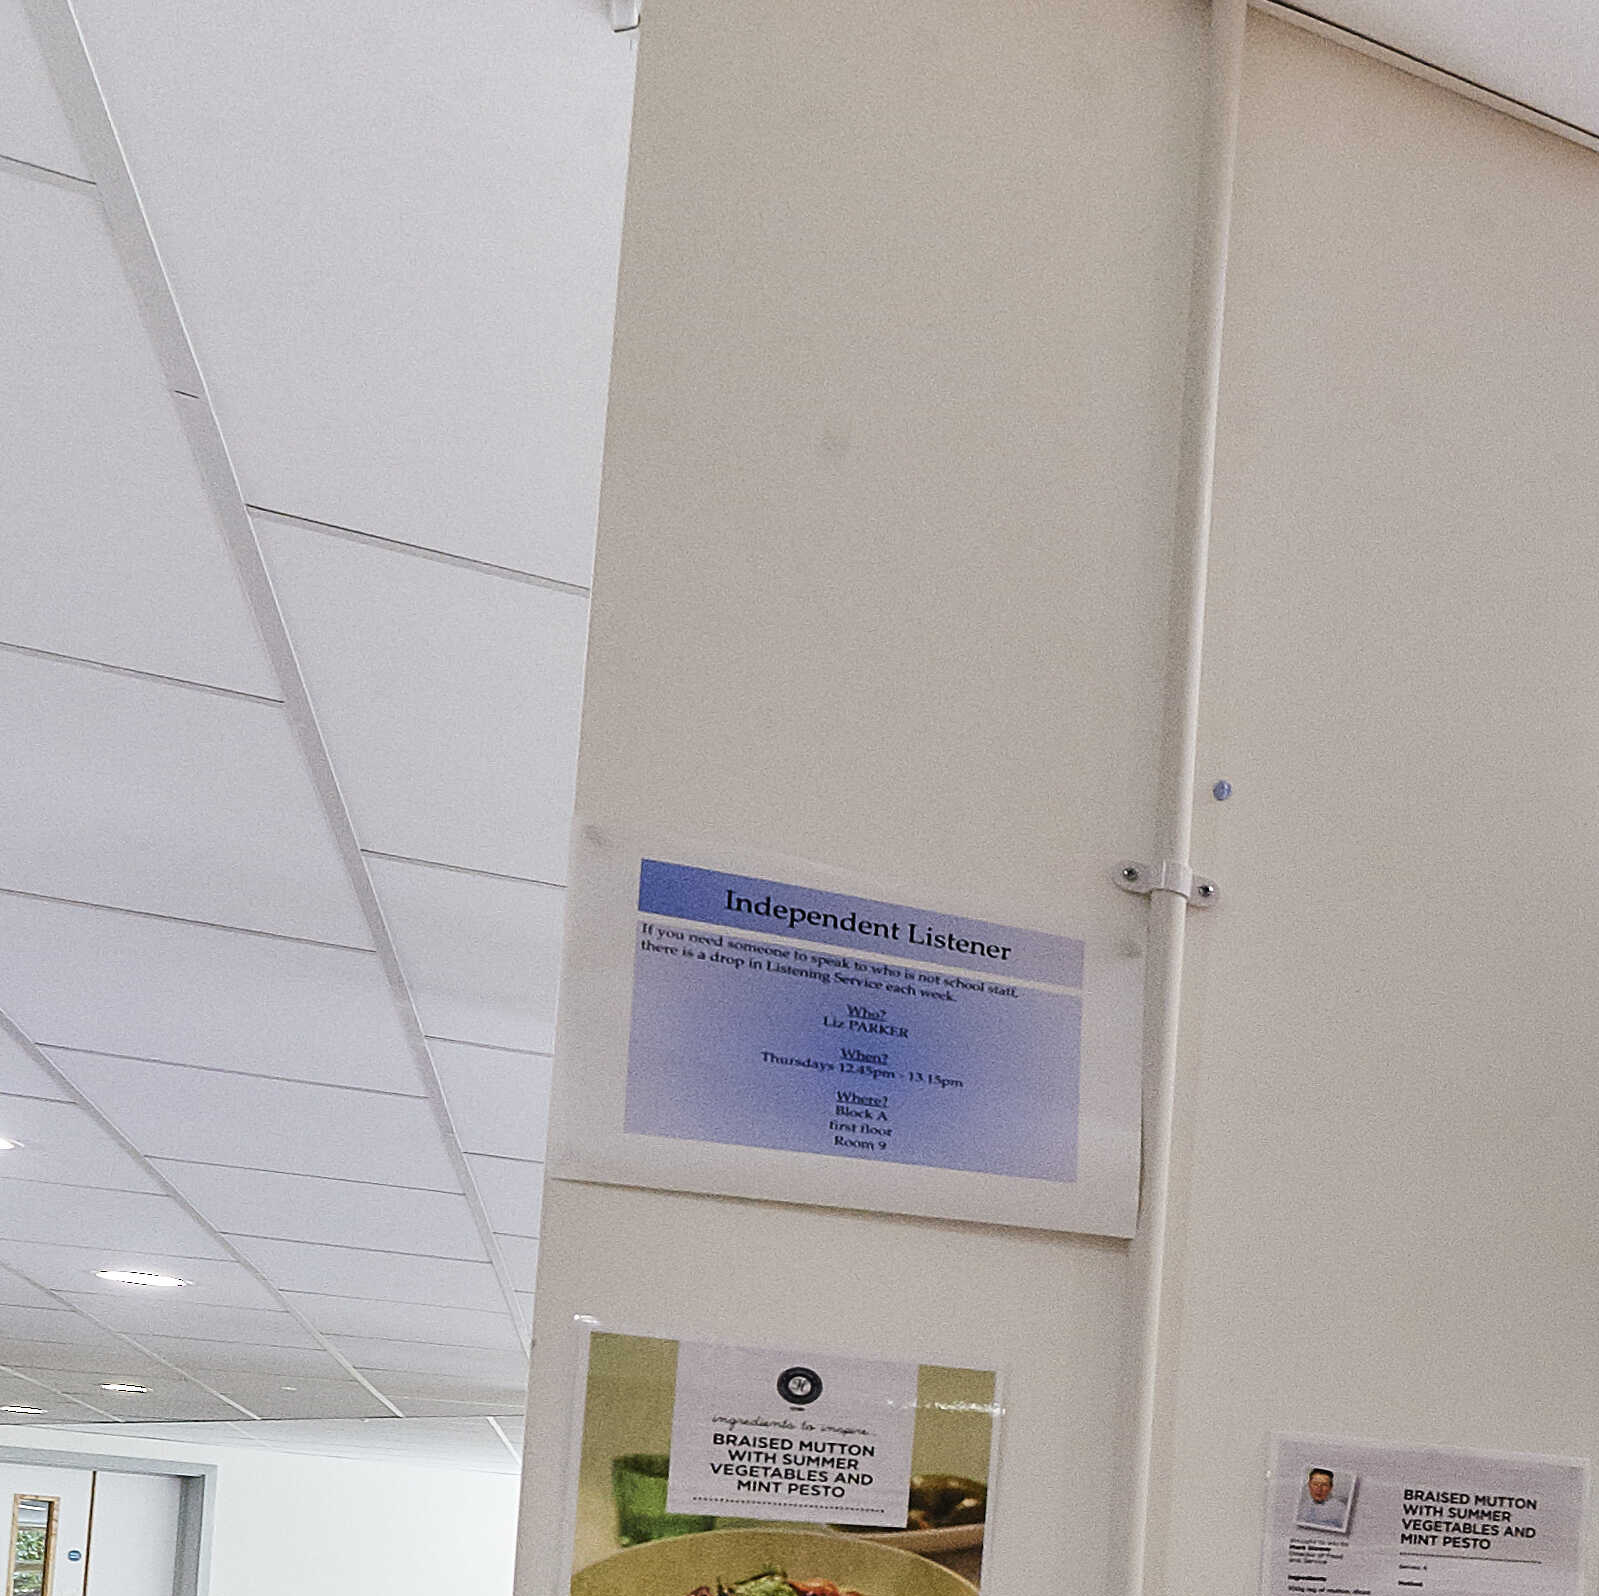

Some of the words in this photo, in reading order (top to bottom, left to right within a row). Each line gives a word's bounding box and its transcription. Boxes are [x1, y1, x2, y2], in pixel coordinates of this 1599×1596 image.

[725, 889, 900, 940] Independent
[908, 923, 1012, 960] Listener
[641, 940, 678, 955] there
[682, 946, 694, 958] is
[697, 952, 706, 961] a
[710, 952, 745, 969] drop
[750, 958, 762, 971] in
[766, 960, 831, 983] Listening
[834, 971, 883, 991] Service
[885, 983, 916, 997] each
[642, 923, 653, 935] If
[656, 927, 684, 941] you
[688, 933, 723, 947] need
[727, 940, 790, 959] someone
[793, 950, 807, 962] to
[811, 953, 850, 969] speak
[853, 958, 868, 971] to
[871, 963, 900, 977] who
[904, 968, 915, 981] is
[918, 972, 941, 986] not
[944, 976, 984, 993] school
[847, 1004, 888, 1022] Who?
[823, 1015, 844, 1028] Liz
[849, 1019, 909, 1039] PARKER
[760, 1051, 834, 1072] Thursdays
[840, 1047, 889, 1066] When?
[836, 1090, 888, 1108] Where?
[835, 1105, 873, 1120] Block
[876, 1111, 888, 1121] A
[829, 1120, 856, 1133] first
[860, 1123, 893, 1137] floor
[834, 1135, 874, 1151] Room
[878, 1141, 887, 1150] 9
[712, 1432, 794, 1451] BRAISED
[798, 1440, 875, 1457] MUTTON
[728, 1449, 777, 1464] WITH
[782, 1453, 859, 1471] SUMMER
[709, 1462, 829, 1483] VEGETABLES
[834, 1472, 874, 1486] AND
[736, 1479, 782, 1494] MINT
[788, 1483, 846, 1498] PESTO
[1403, 1488, 1470, 1505] BRAISED
[1474, 1494, 1537, 1511] MUTTON
[1402, 1503, 1444, 1517] WITH
[1448, 1506, 1512, 1523] SUMMER
[1401, 1518, 1500, 1536] VEGETABLES
[1503, 1525, 1537, 1539] AND
[1400, 1533, 1438, 1546] MINT
[1442, 1536, 1491, 1550] PESTO
